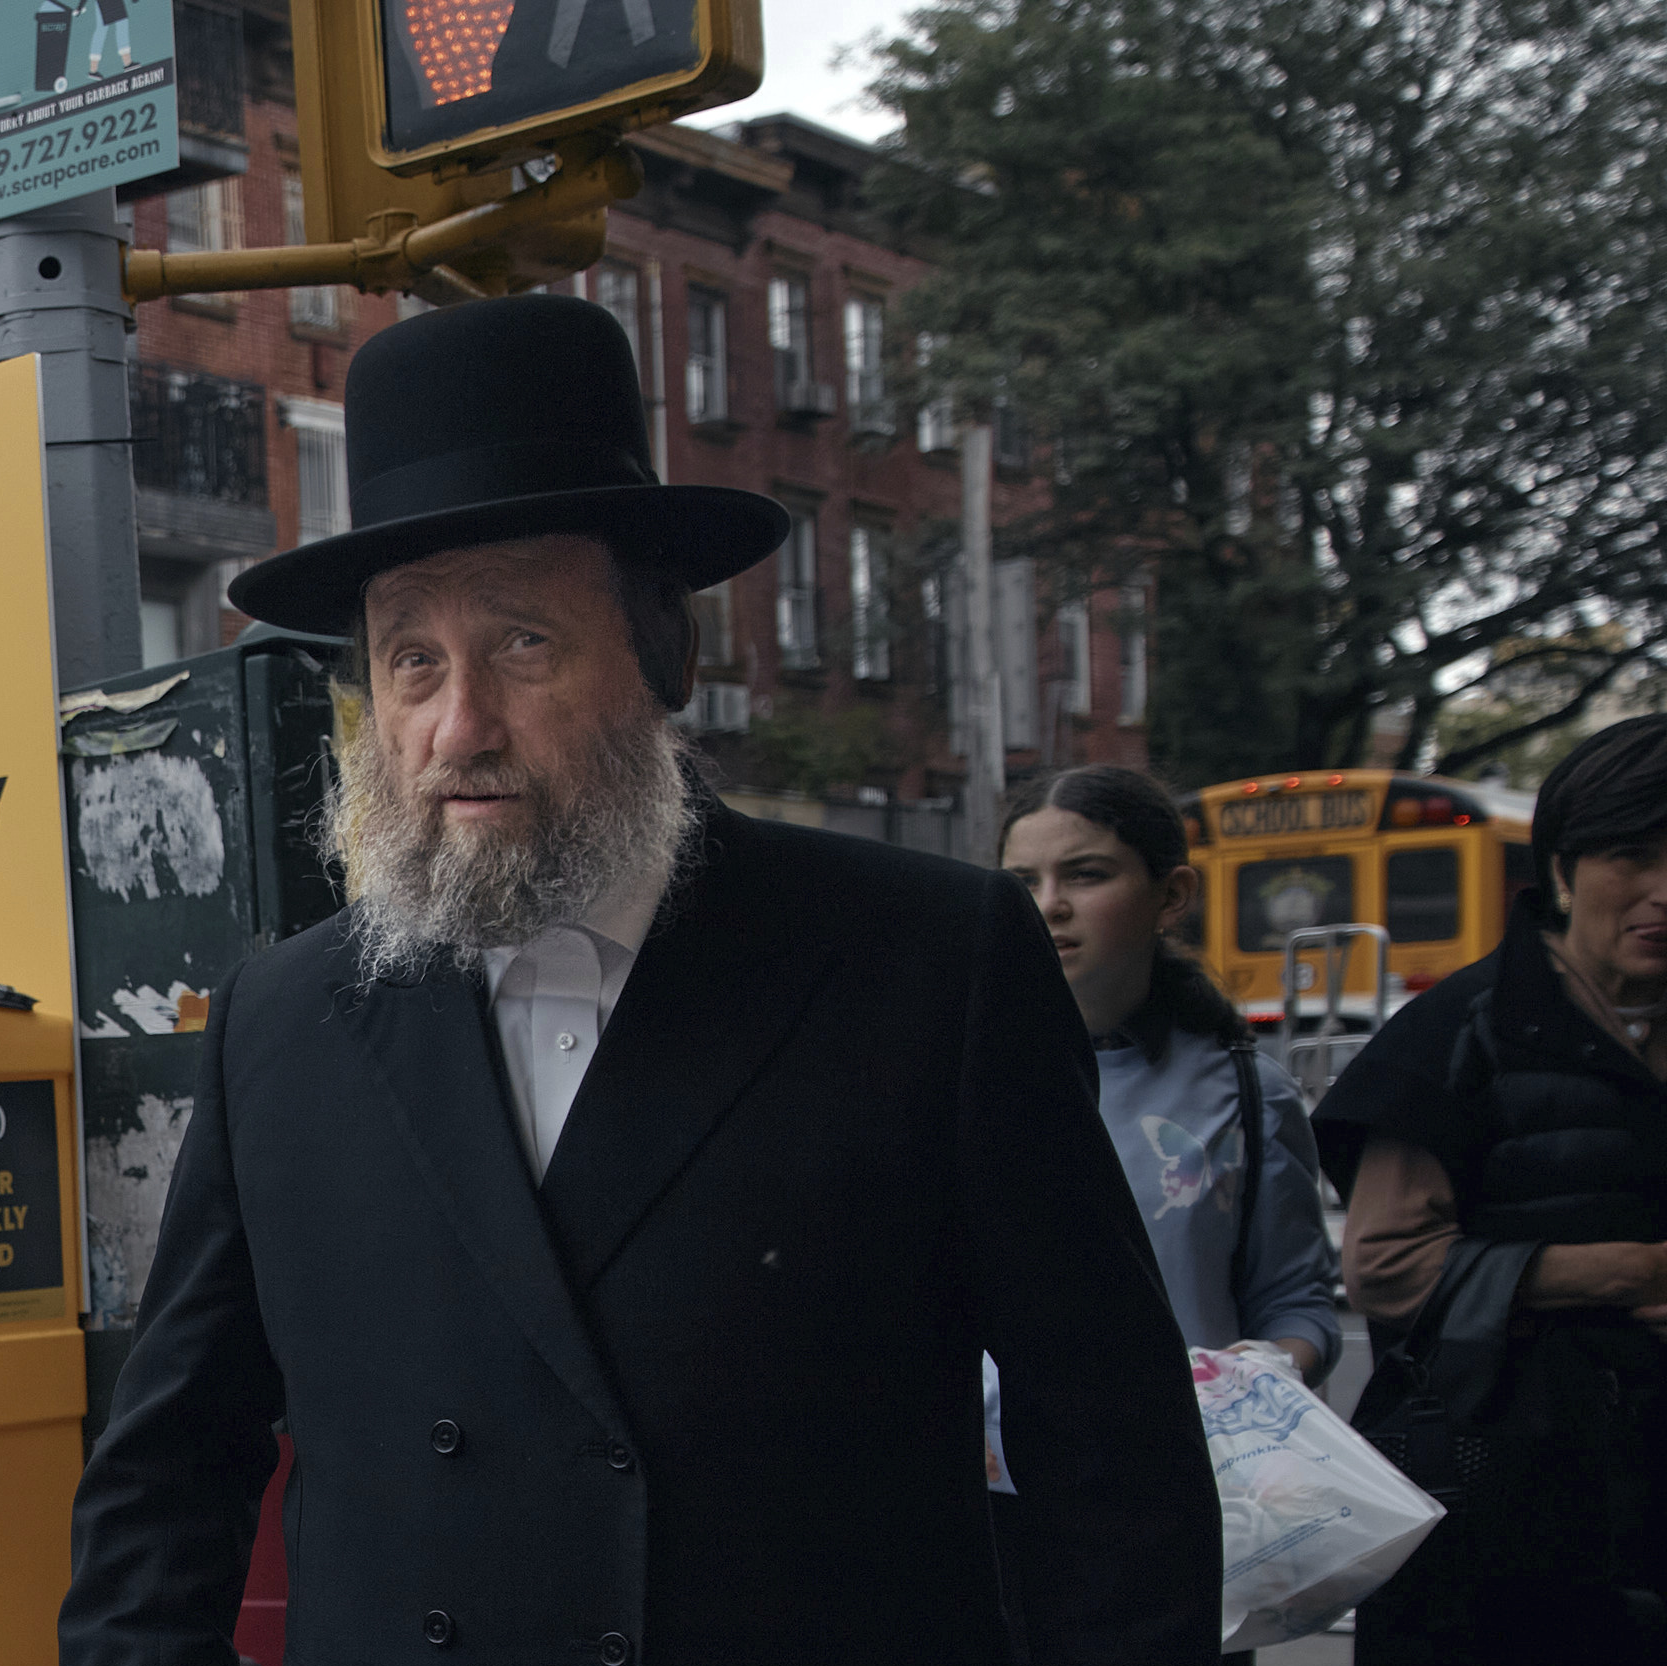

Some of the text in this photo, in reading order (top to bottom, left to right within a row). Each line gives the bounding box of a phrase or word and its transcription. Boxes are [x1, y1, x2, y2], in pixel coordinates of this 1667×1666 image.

[40, 22, 67, 34] scrap
[27, 103, 57, 125] ABOUT
[59, 94, 84, 116] YOUR
[86, 80, 130, 107] GARBAGE
[131, 67, 165, 91] AGAIN!
[1226, 790, 1367, 836] SCHOOL BUS
